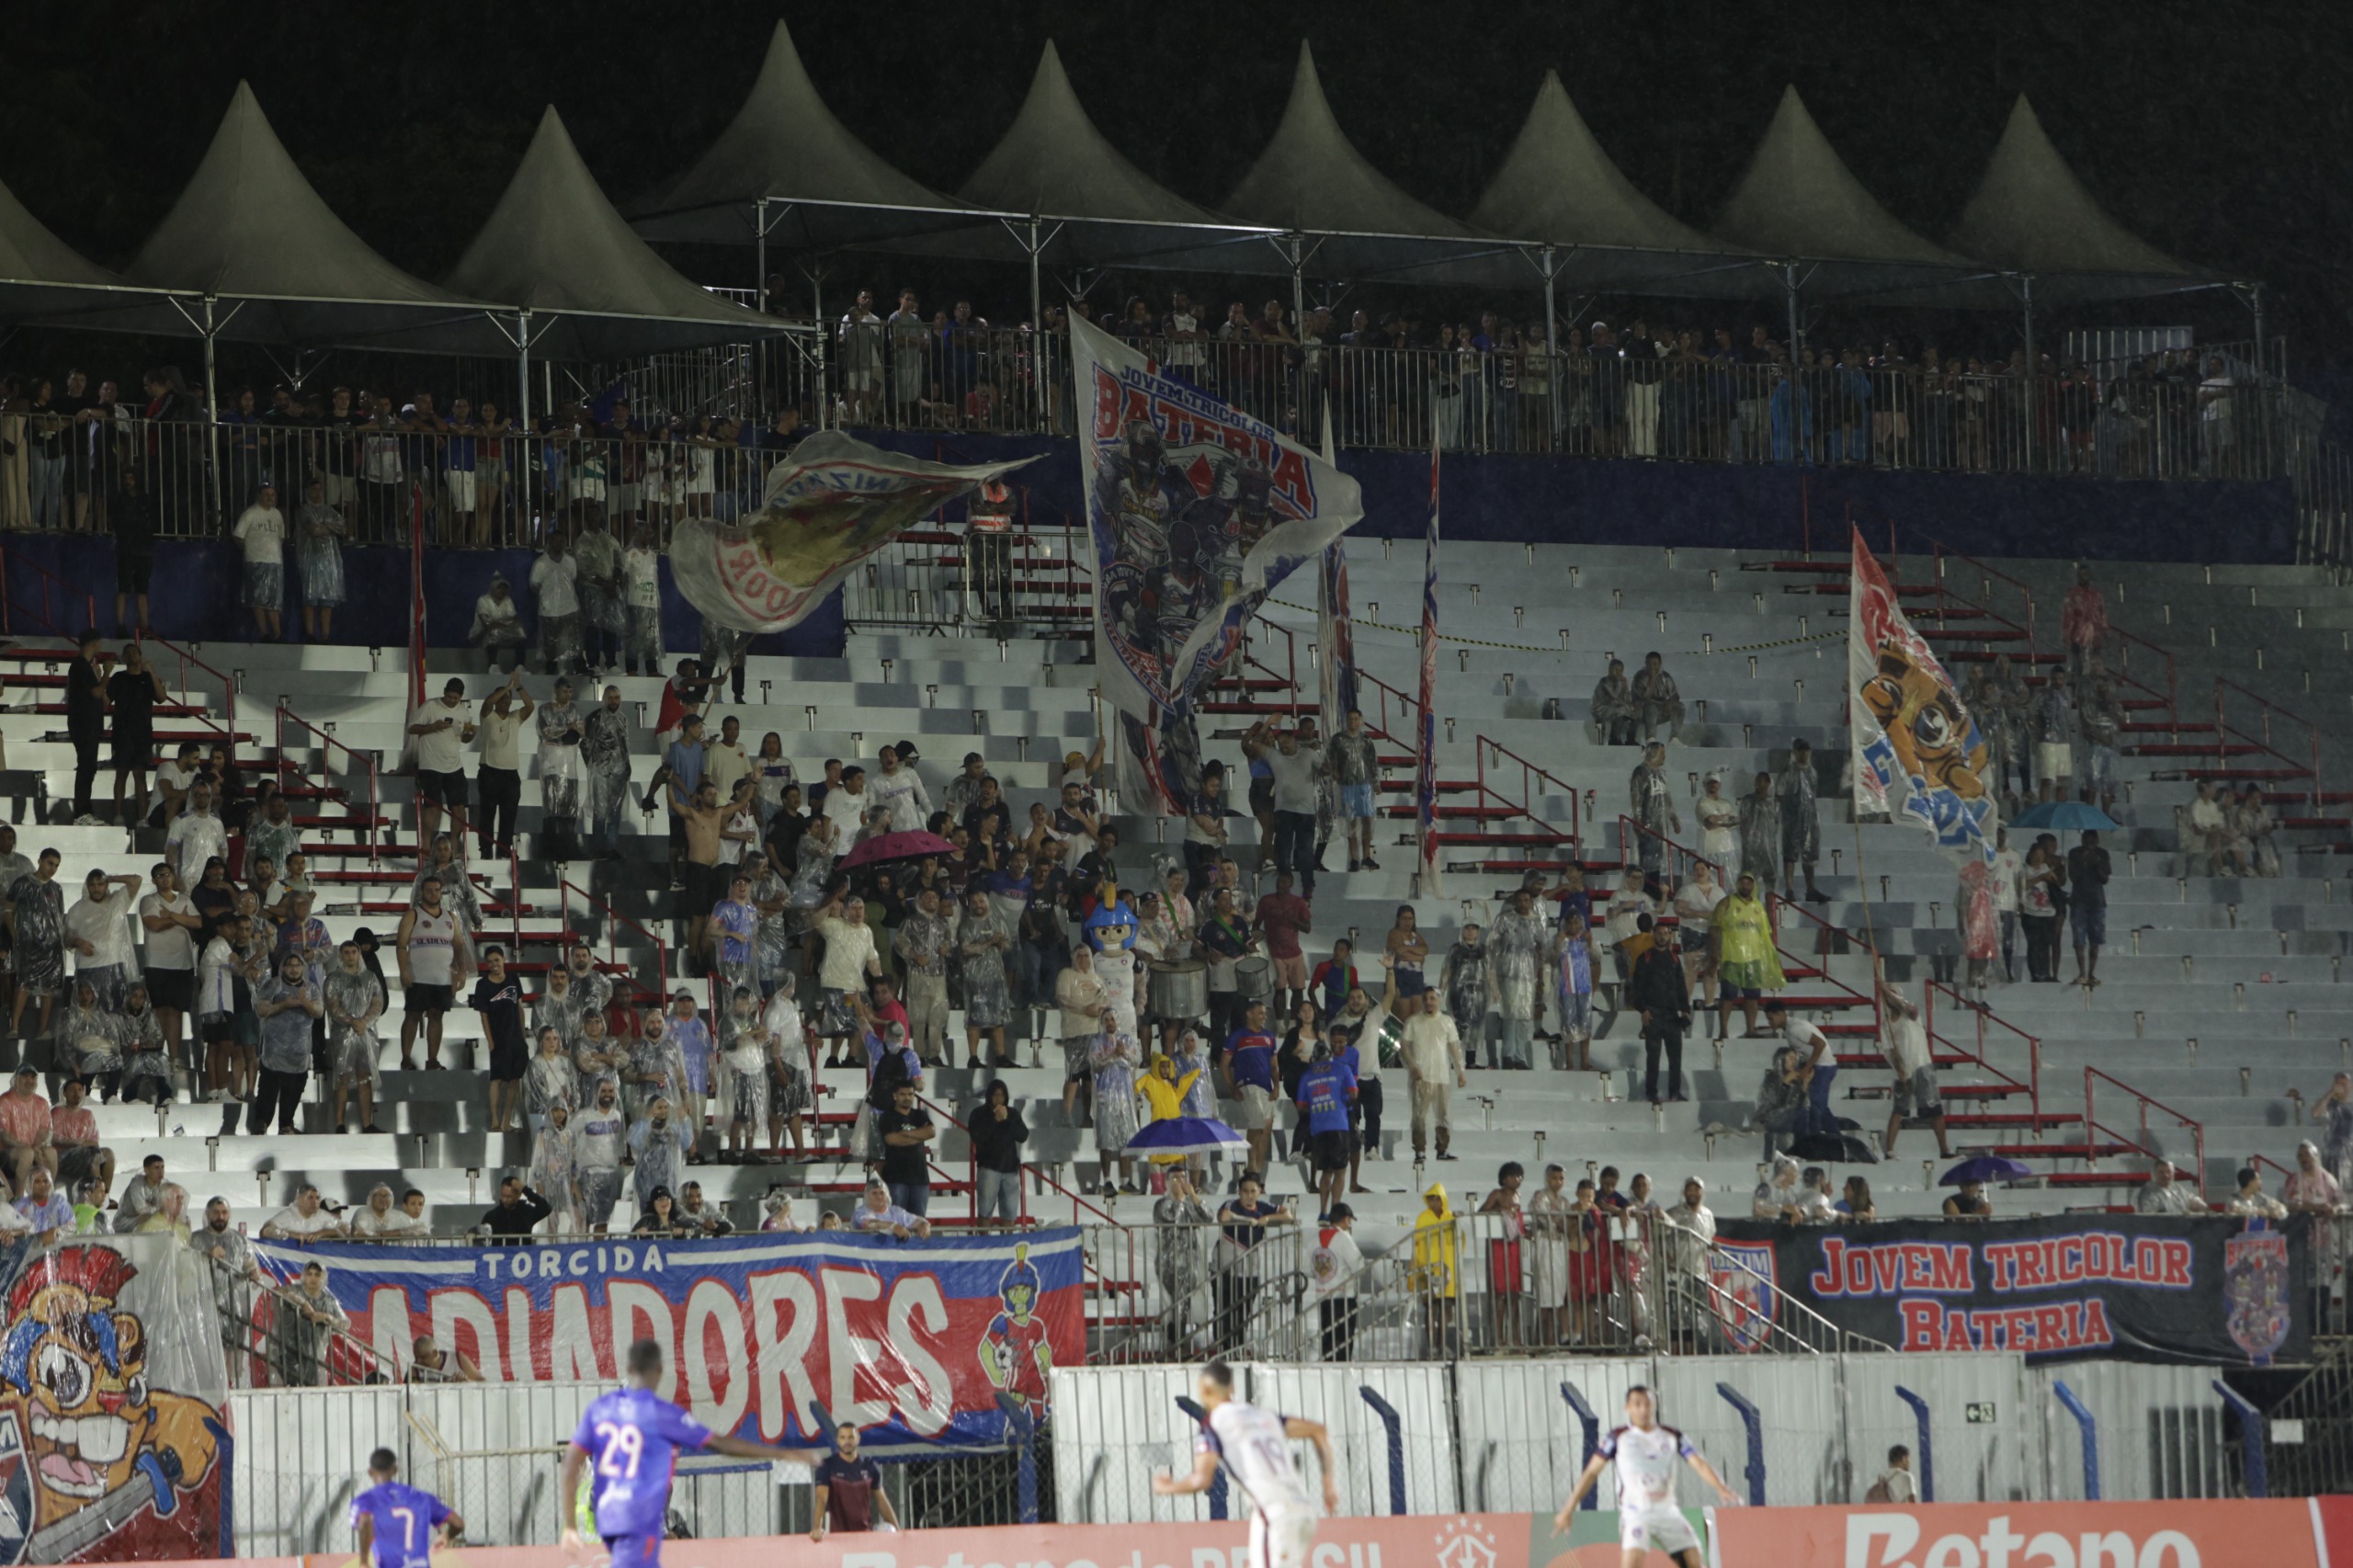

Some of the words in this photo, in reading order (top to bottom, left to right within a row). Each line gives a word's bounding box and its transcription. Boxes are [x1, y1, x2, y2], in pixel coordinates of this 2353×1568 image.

[1120, 365, 1185, 403] JOVEM
[1186, 390, 1276, 444] TRICOLOR
[1092, 361, 1317, 519] BATERIA
[483, 1244, 663, 1278] TORCIDA
[1811, 1237, 1974, 1295] JOVEM
[1984, 1233, 2193, 1290] TRICOLOR
[1899, 1297, 2112, 1352] BATERIA
[595, 1421, 643, 1478] 29
[391, 1506, 415, 1551] 7
